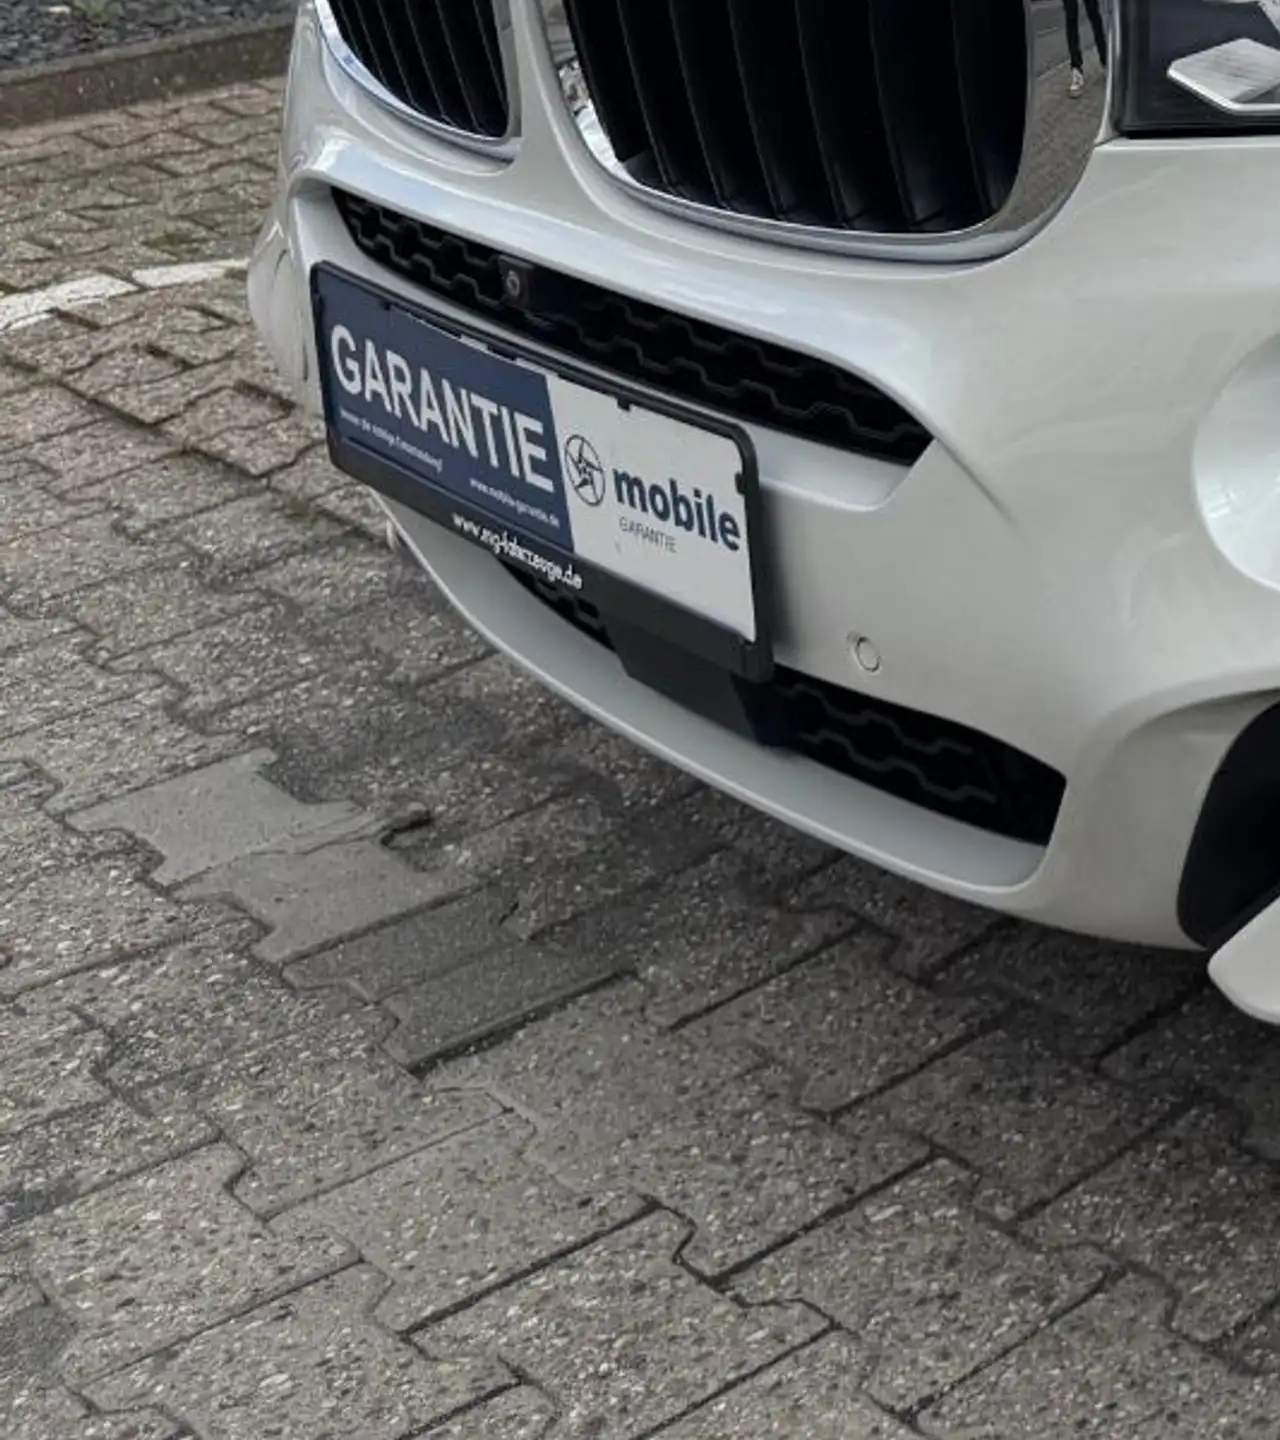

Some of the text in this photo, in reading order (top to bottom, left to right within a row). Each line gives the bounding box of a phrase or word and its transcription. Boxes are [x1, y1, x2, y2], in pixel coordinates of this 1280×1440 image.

[330, 324, 556, 494] GARANTIE
[612, 467, 741, 552] mobile
[618, 515, 678, 554] GARANTIE
